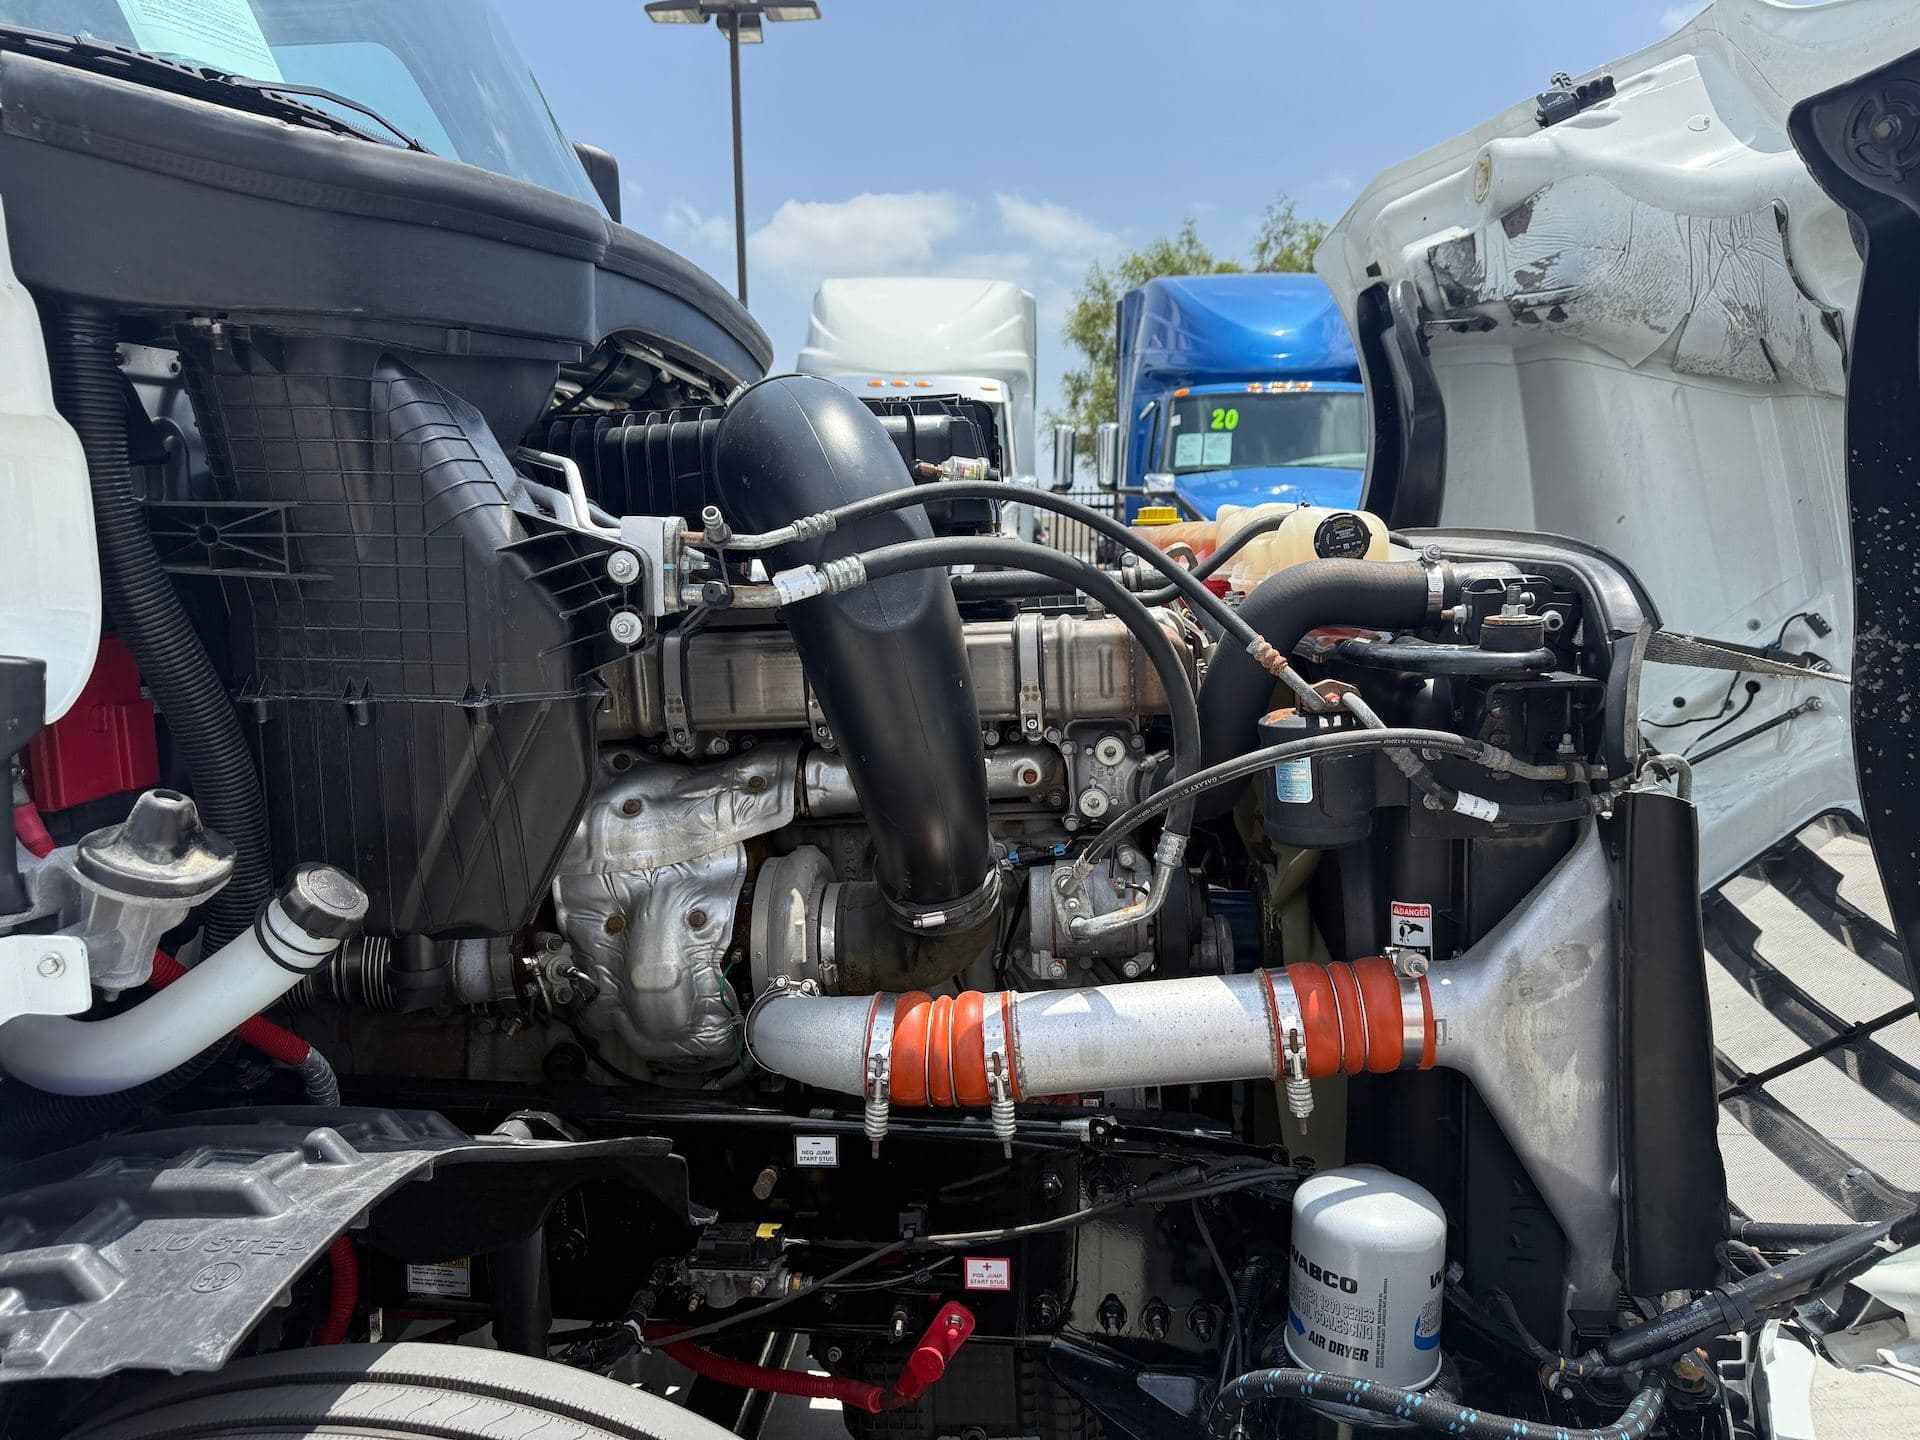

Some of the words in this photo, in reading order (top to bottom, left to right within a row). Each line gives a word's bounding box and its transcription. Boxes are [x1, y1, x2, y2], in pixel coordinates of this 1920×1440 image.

[1211, 408, 1239, 430] 20
[1400, 907, 1429, 917] DANGER
[135, 1233, 200, 1252] NO
[203, 1237, 311, 1256] STEP
[1321, 1295, 1341, 1317] 1200
[1342, 1302, 1375, 1324] SERIES
[1314, 1308, 1374, 1341] COALESCING
[1308, 1330, 1326, 1349] AIR
[1328, 1340, 1369, 1362] DRYER
